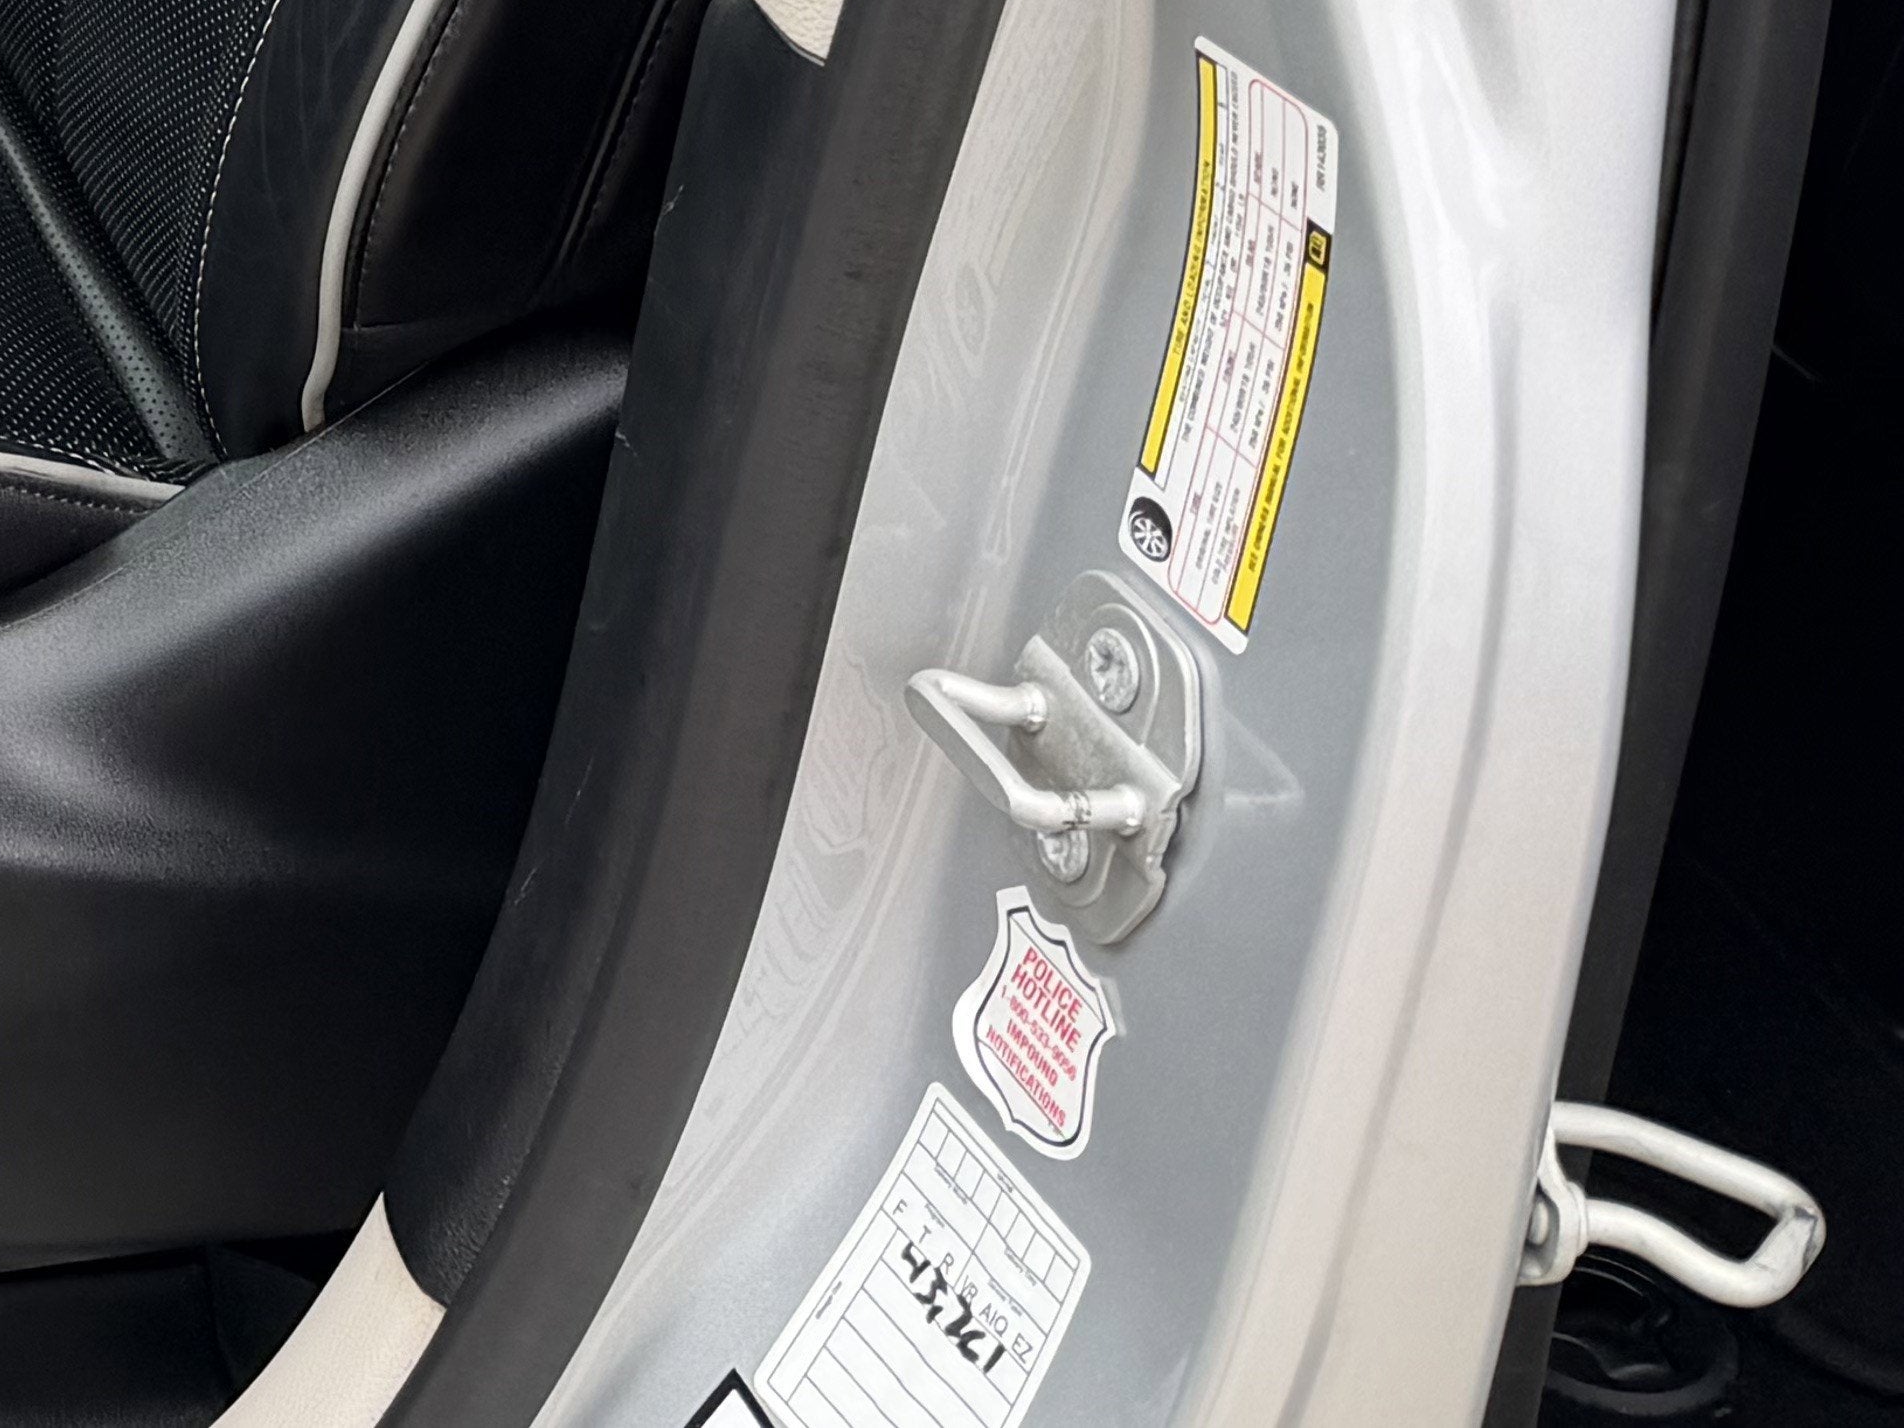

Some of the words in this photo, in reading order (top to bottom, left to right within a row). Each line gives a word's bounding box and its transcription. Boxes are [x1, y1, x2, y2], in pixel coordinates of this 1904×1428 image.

[1010, 964, 1082, 1053] HOTLINE
[1022, 946, 1082, 1023] POLICE
[986, 1024, 1066, 1127] NOTIFICATIONS
[1006, 1018, 1059, 1087] IMPOUND
[893, 1198, 907, 1215] F
[918, 1225, 932, 1244] T
[941, 1252, 956, 1275] R
[978, 1302, 1009, 1338] AIQ
[1011, 1332, 1033, 1364] EZ
